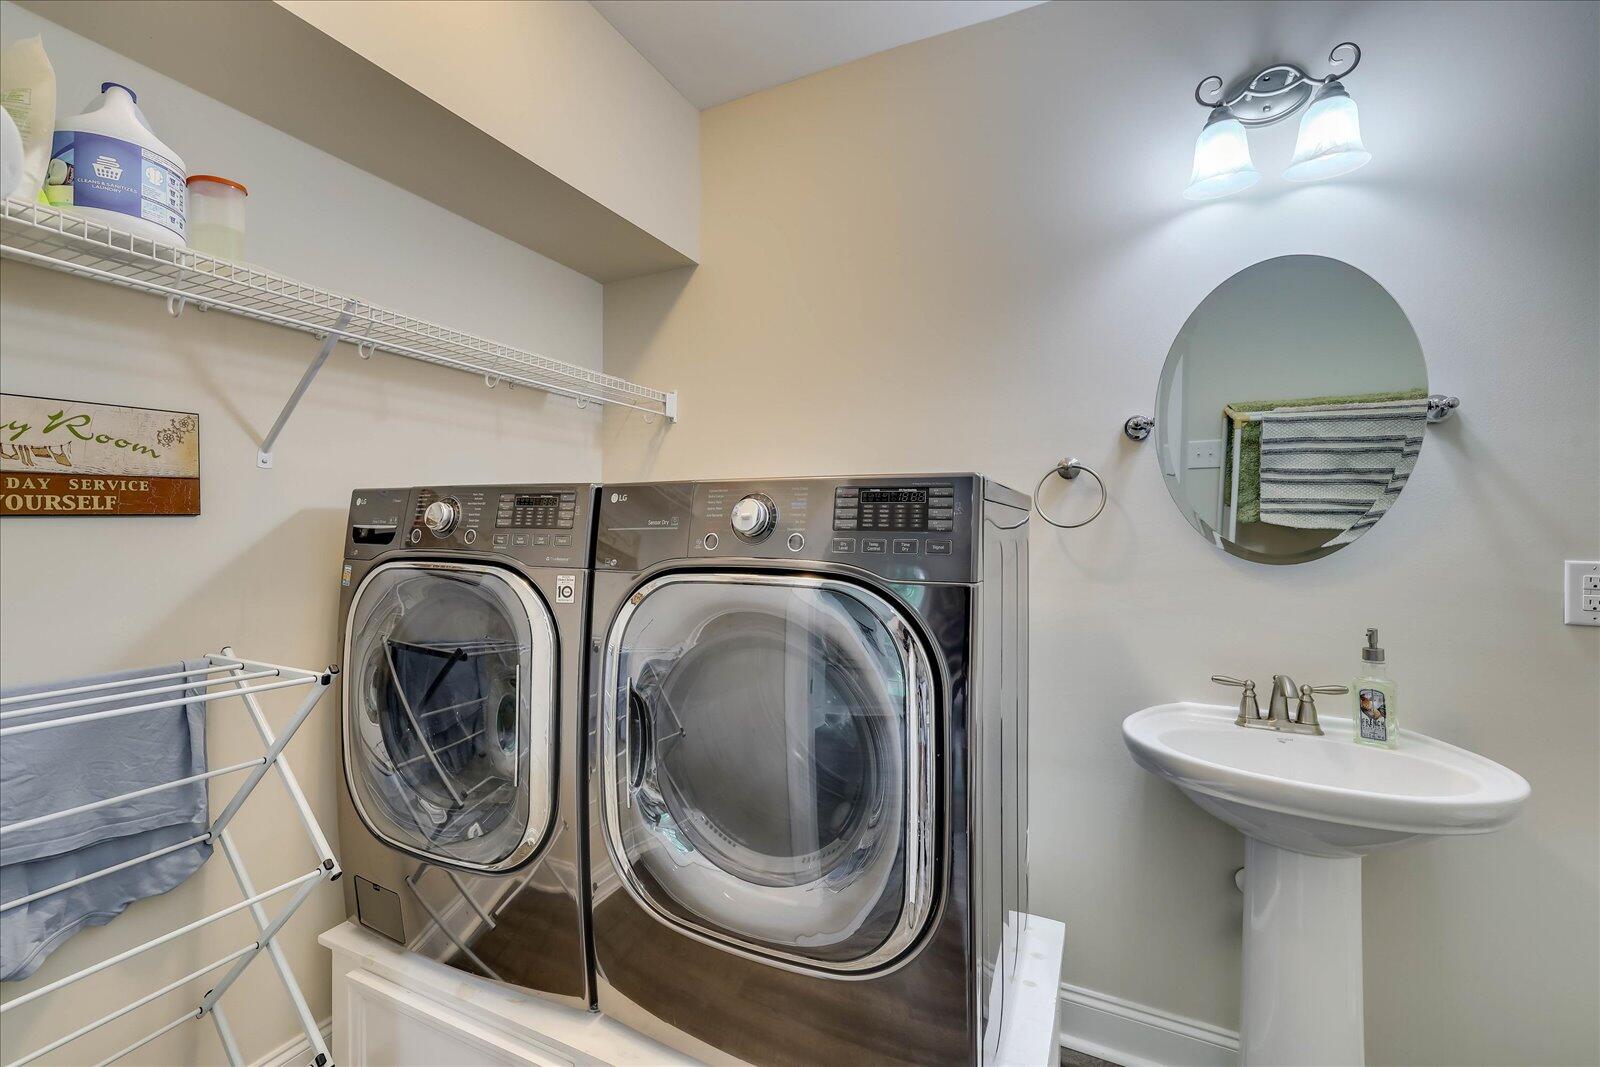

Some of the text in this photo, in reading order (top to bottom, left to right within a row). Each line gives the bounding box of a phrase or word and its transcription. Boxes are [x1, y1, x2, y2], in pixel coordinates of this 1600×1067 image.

[91, 185, 122, 193] LAUNDRY
[43, 410, 160, 459] Room
[6, 477, 149, 491] DAY SERVICE
[558, 586, 573, 598] 10
